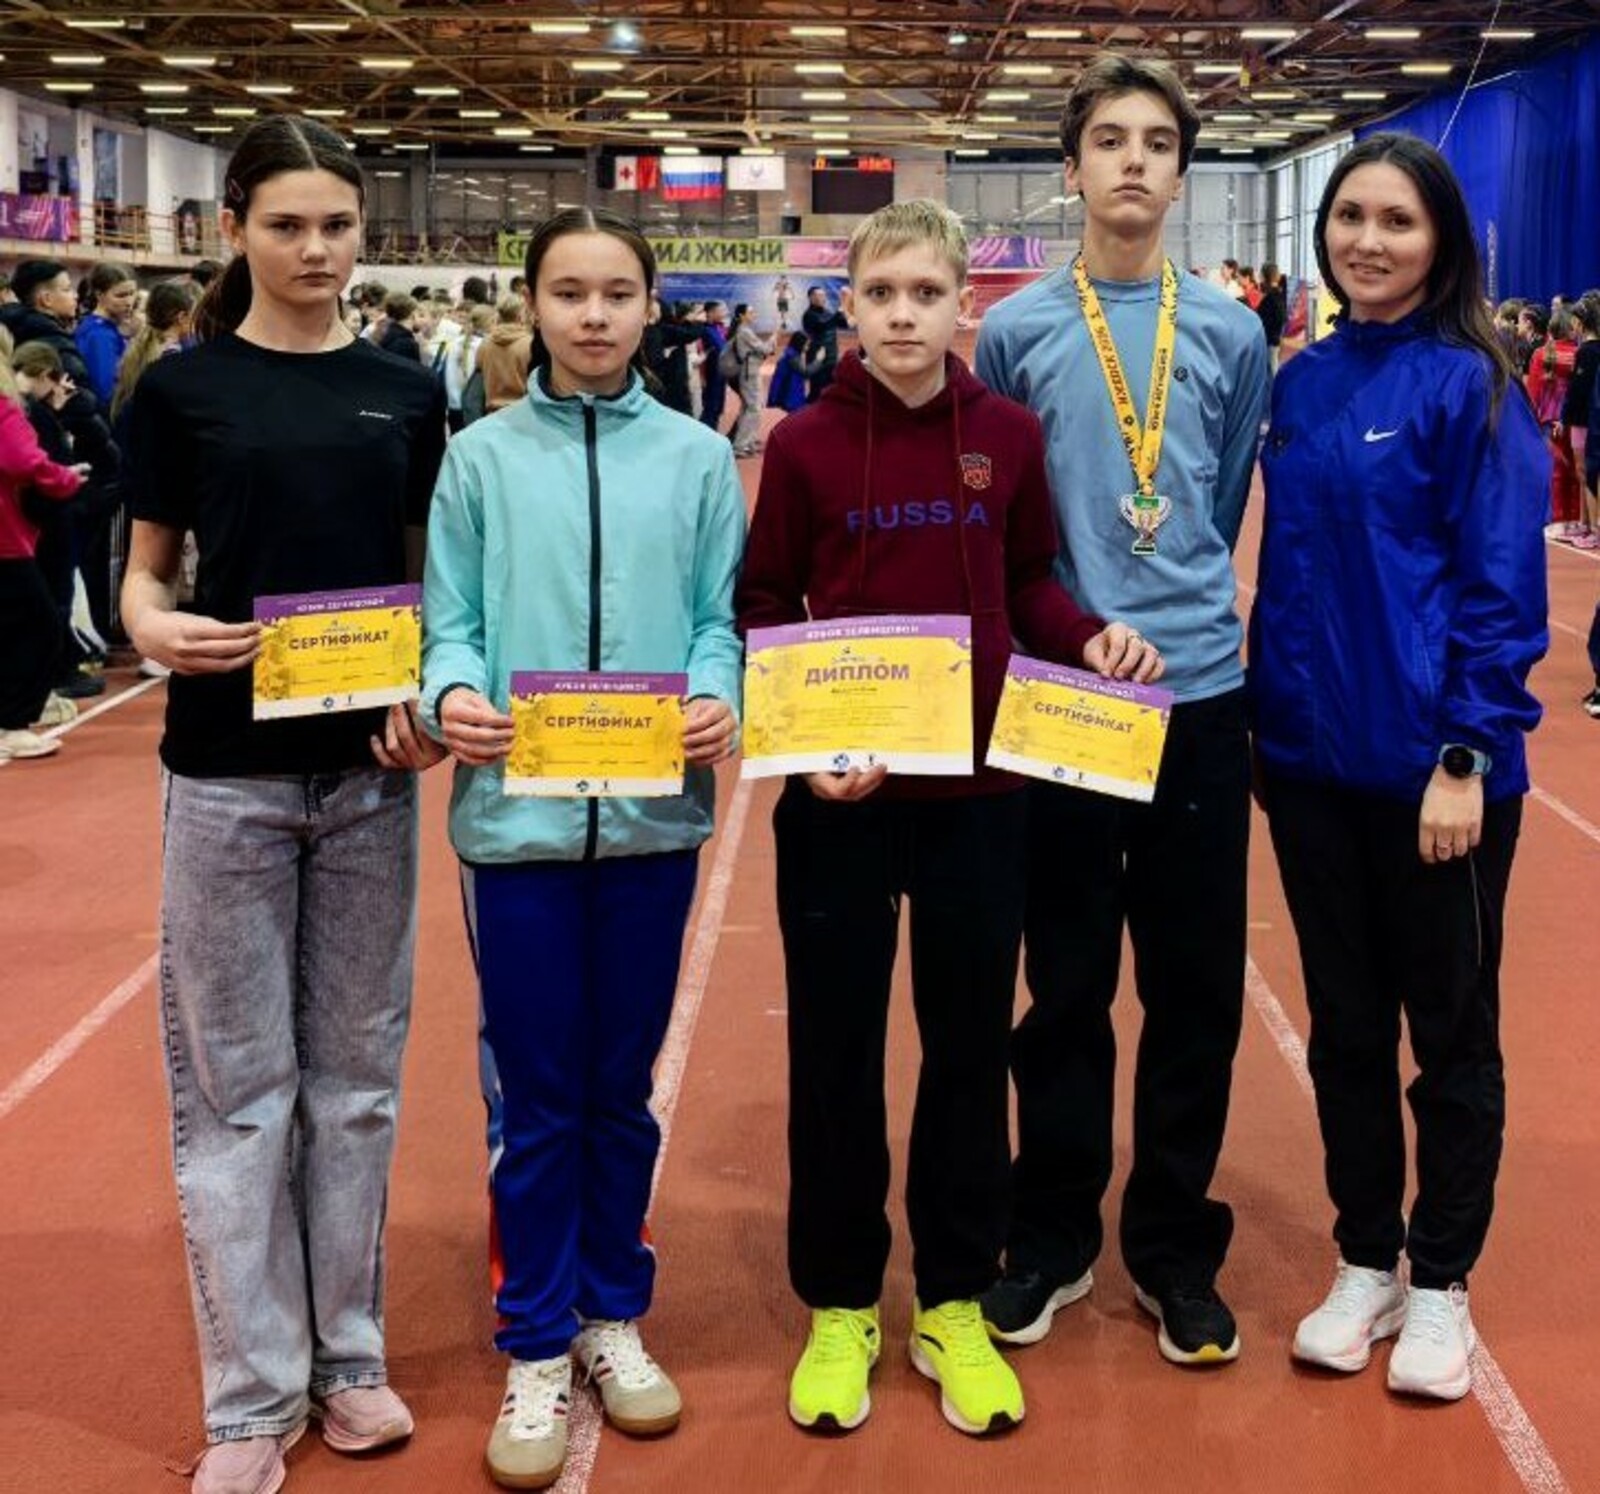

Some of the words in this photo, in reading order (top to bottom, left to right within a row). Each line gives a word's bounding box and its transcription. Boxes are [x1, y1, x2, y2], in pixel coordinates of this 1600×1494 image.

[695, 241, 784, 264] ЖИЗНИ
[846, 499, 989, 533] RUSSA
[288, 630, 389, 651] СЕРТИФИКАТ
[805, 663, 910, 687] ДИПЛОМ
[544, 716, 653, 728] СЕРТИФИКАТ
[1034, 700, 1135, 734] СЕРТИФИКАТ
